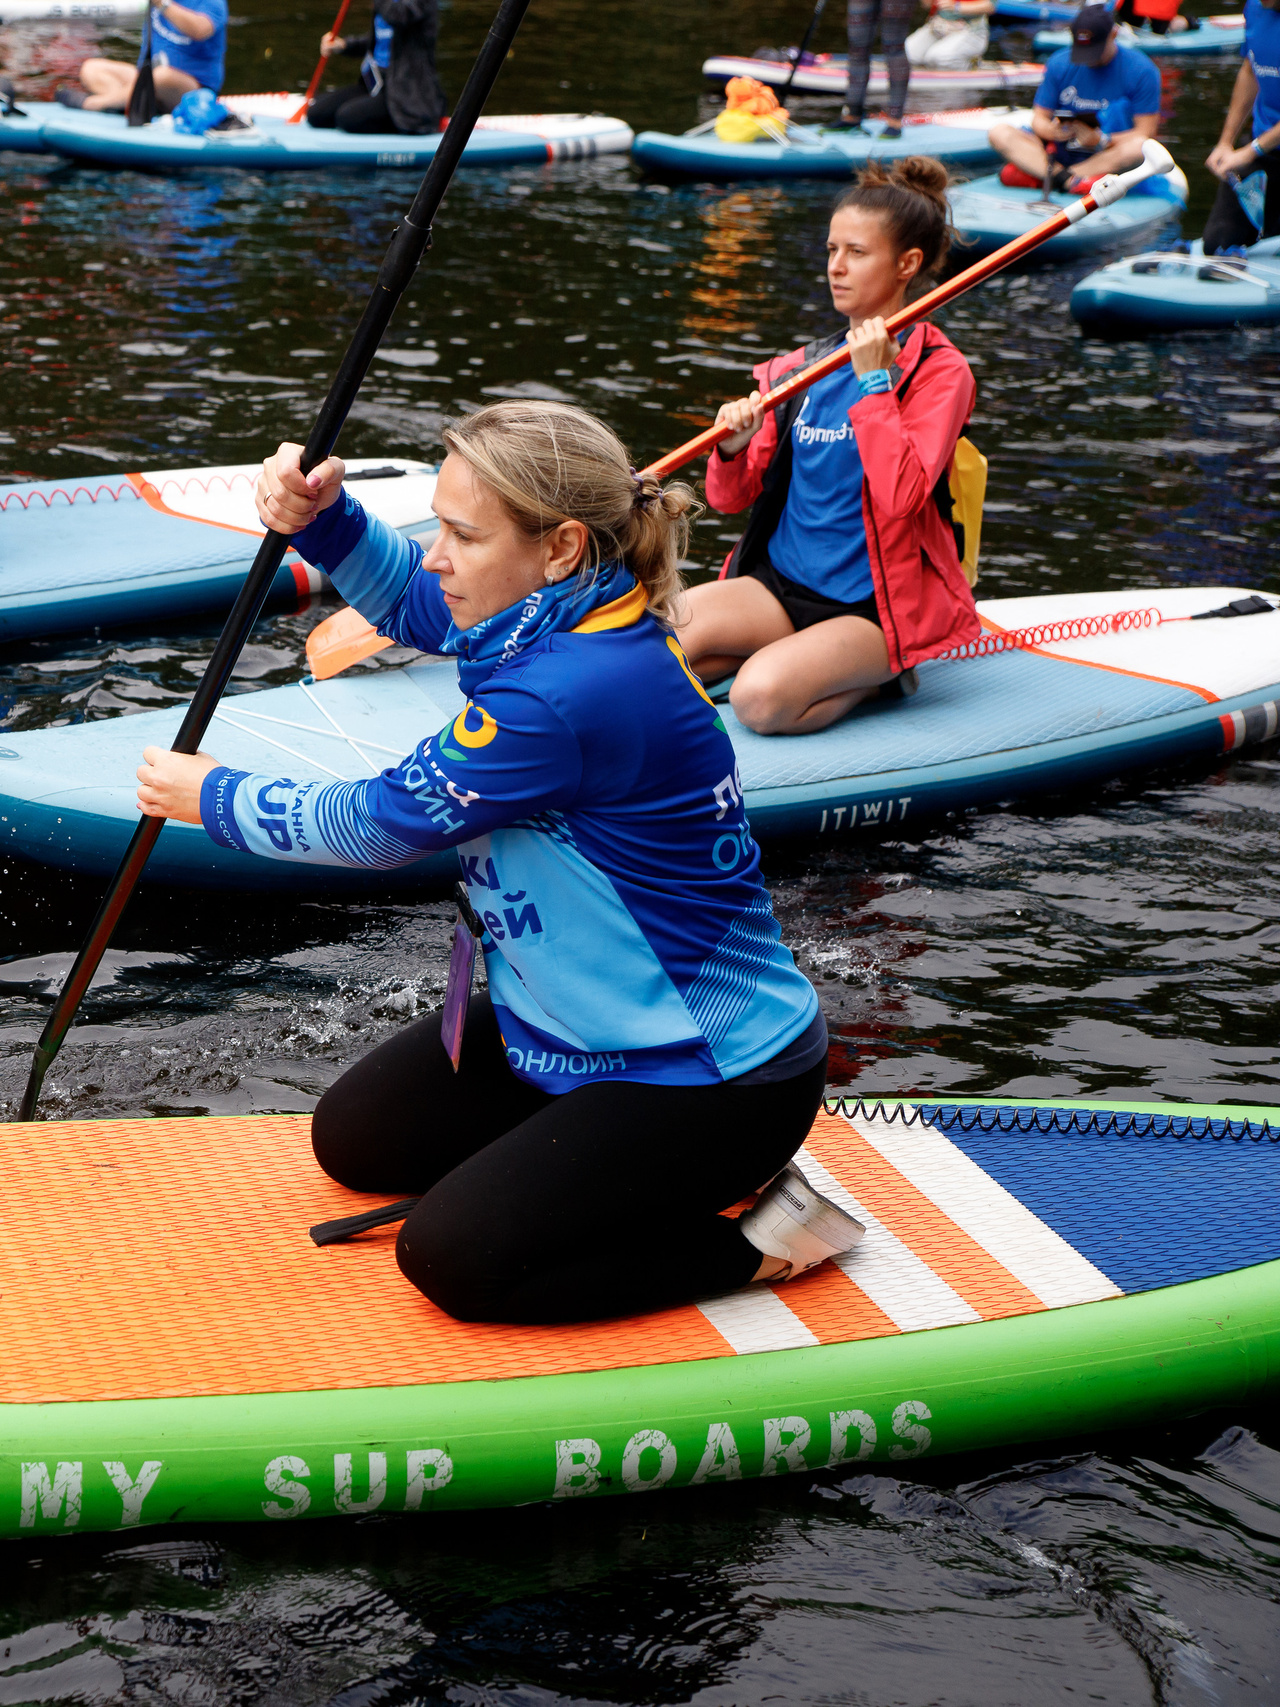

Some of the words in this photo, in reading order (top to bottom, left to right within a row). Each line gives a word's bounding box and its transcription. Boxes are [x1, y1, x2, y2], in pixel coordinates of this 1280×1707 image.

[820, 797, 912, 832] ITIWIT
[19, 1460, 163, 1528] MY
[261, 1448, 454, 1519] SUP
[552, 1400, 932, 1498] BOARDS
